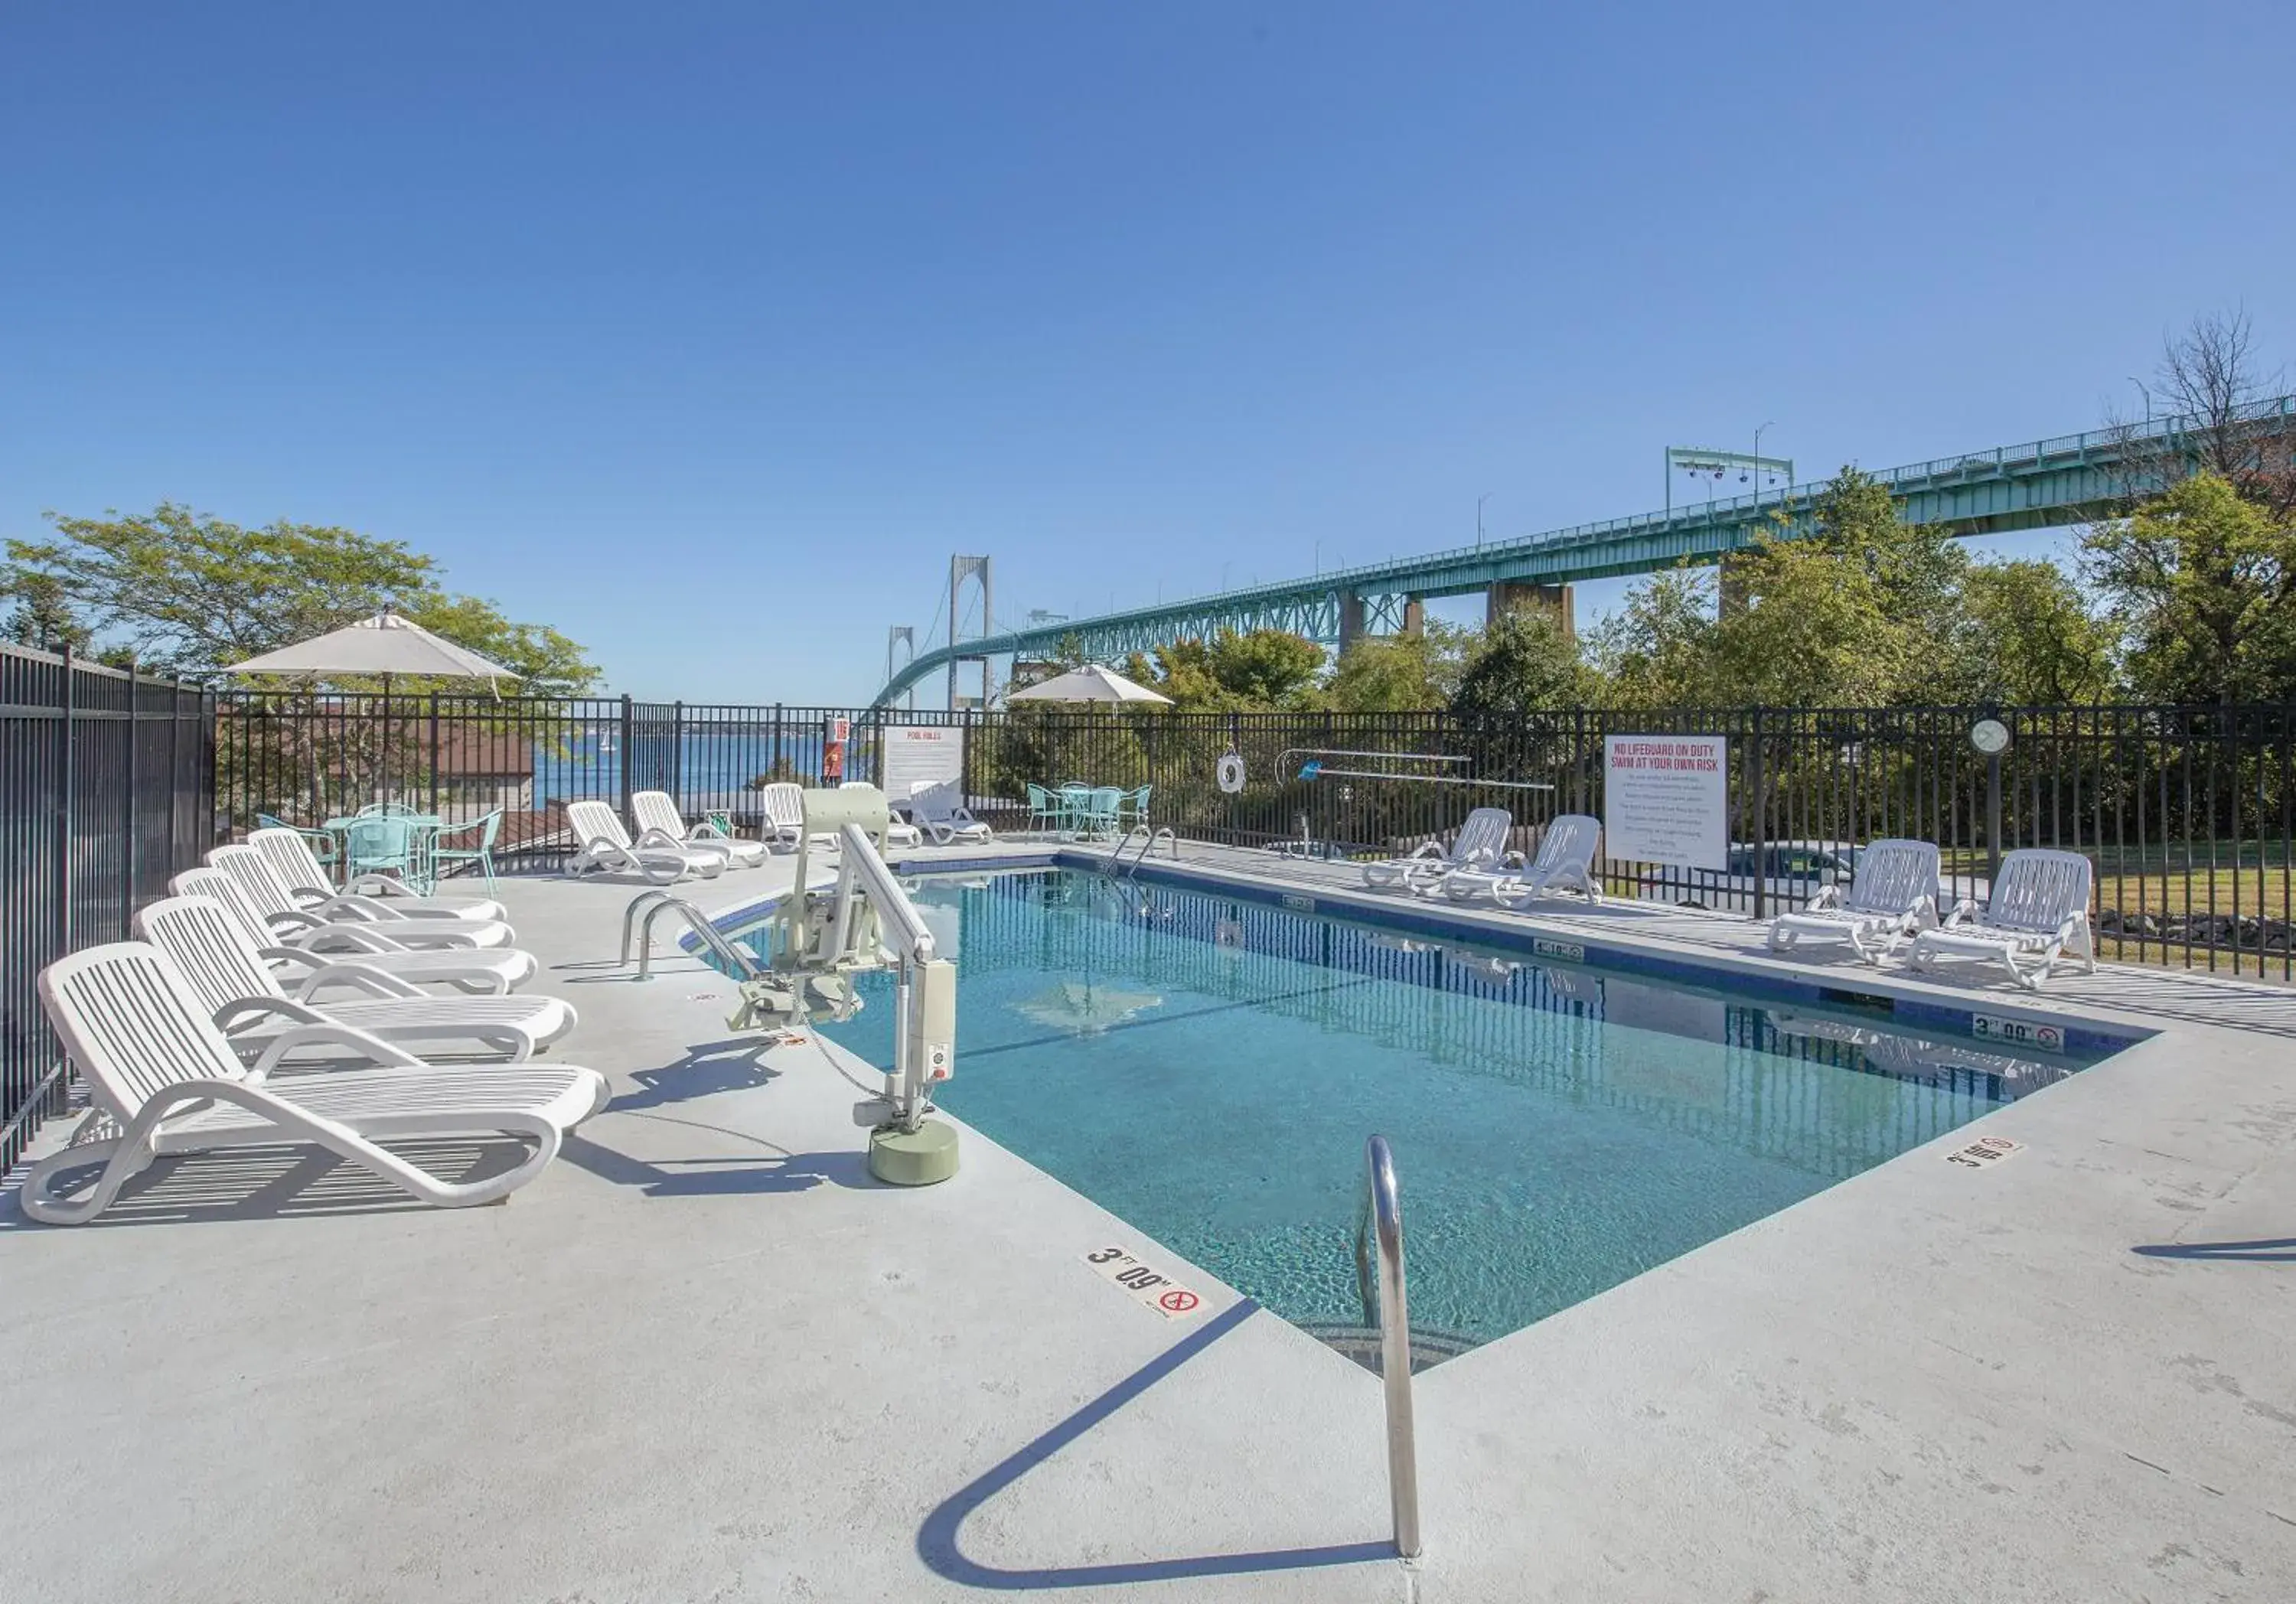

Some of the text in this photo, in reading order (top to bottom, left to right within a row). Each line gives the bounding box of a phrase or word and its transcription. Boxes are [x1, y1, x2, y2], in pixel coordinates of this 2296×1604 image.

[1613, 743, 1715, 757] NO LIFEGUARD ON DUTY
[1611, 756, 1719, 772] SWIM AT YOUR OWN RISK
[1975, 1017, 1989, 1035] 3
[1088, 1248, 1123, 1263] 3
